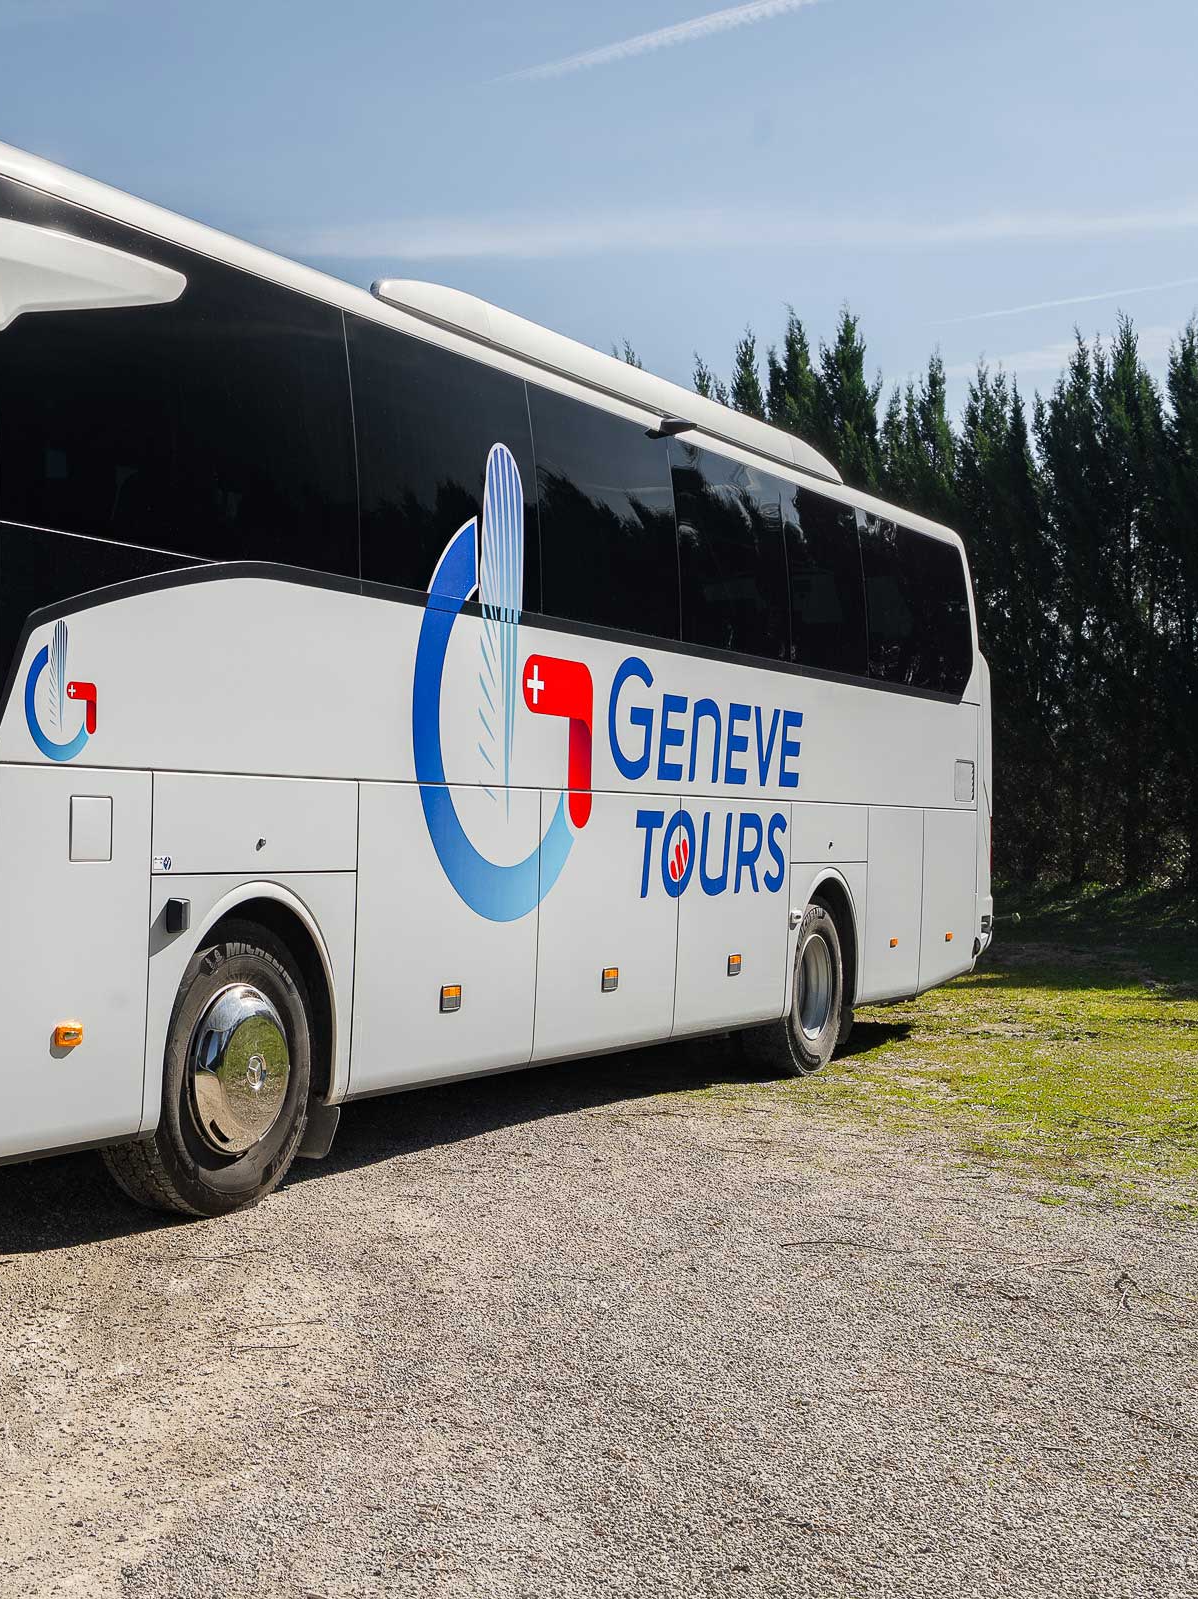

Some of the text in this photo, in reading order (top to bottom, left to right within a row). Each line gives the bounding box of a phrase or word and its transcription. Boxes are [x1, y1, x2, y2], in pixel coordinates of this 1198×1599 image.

[608, 656, 804, 788] GENEVE
[635, 809, 787, 898] TOURS
[225, 942, 293, 985] MICHELIN
